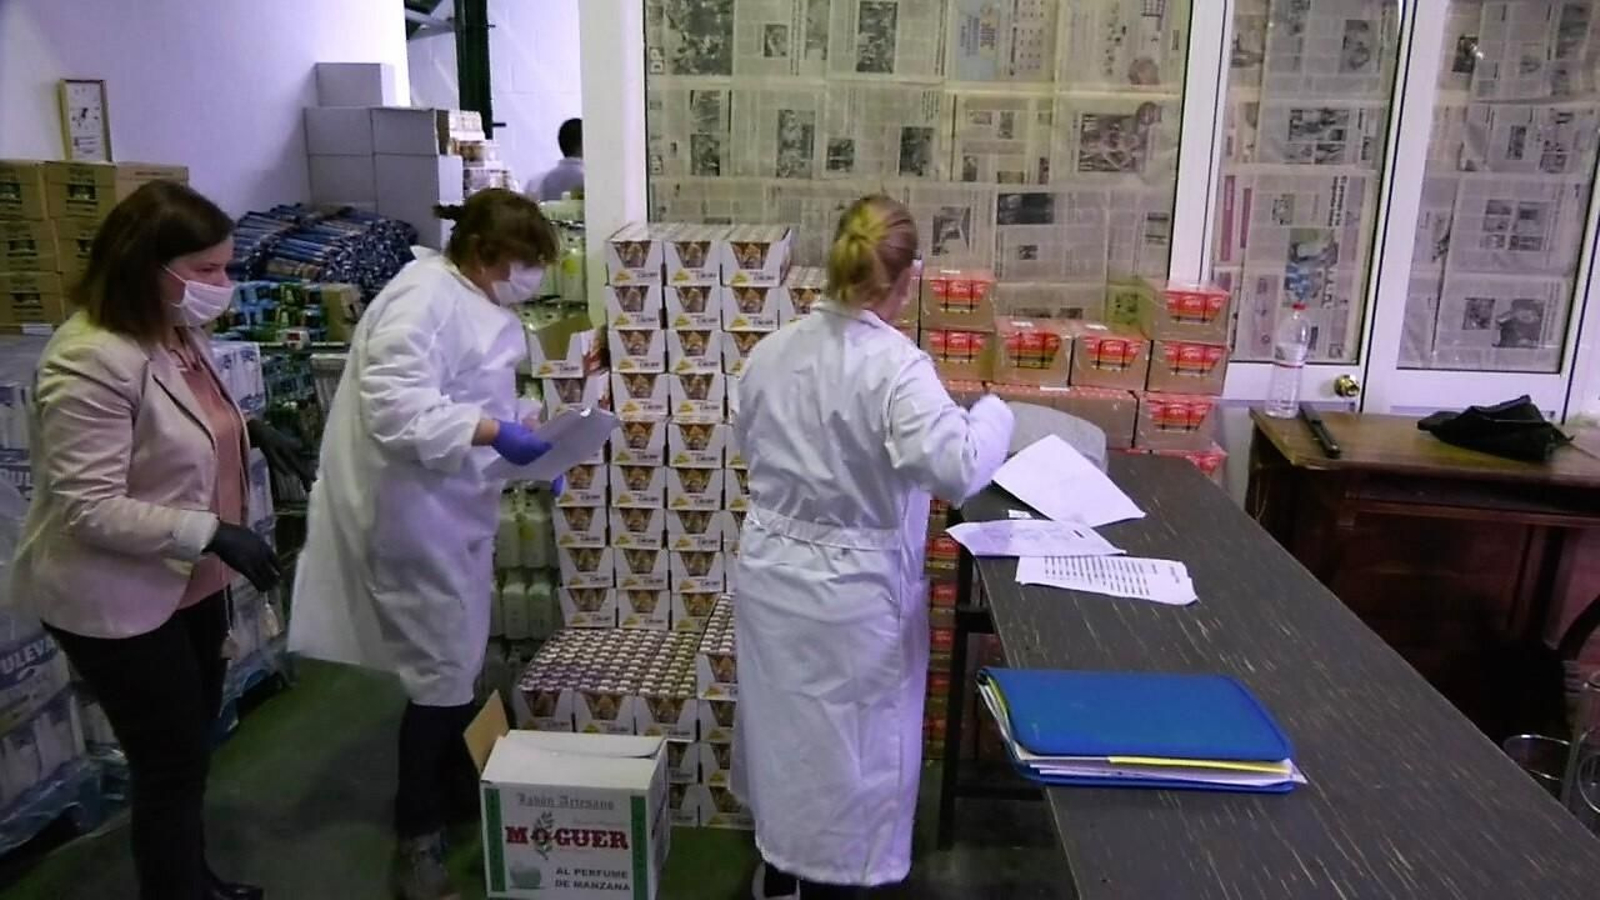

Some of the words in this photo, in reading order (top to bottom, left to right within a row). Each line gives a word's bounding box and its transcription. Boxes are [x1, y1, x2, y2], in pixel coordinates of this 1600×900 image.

[505, 826, 629, 850] MOGUER
[555, 867, 571, 876] AL
[574, 868, 629, 879] PERFUME
[555, 879, 570, 888] DE
[574, 880, 631, 891] MANZANA
